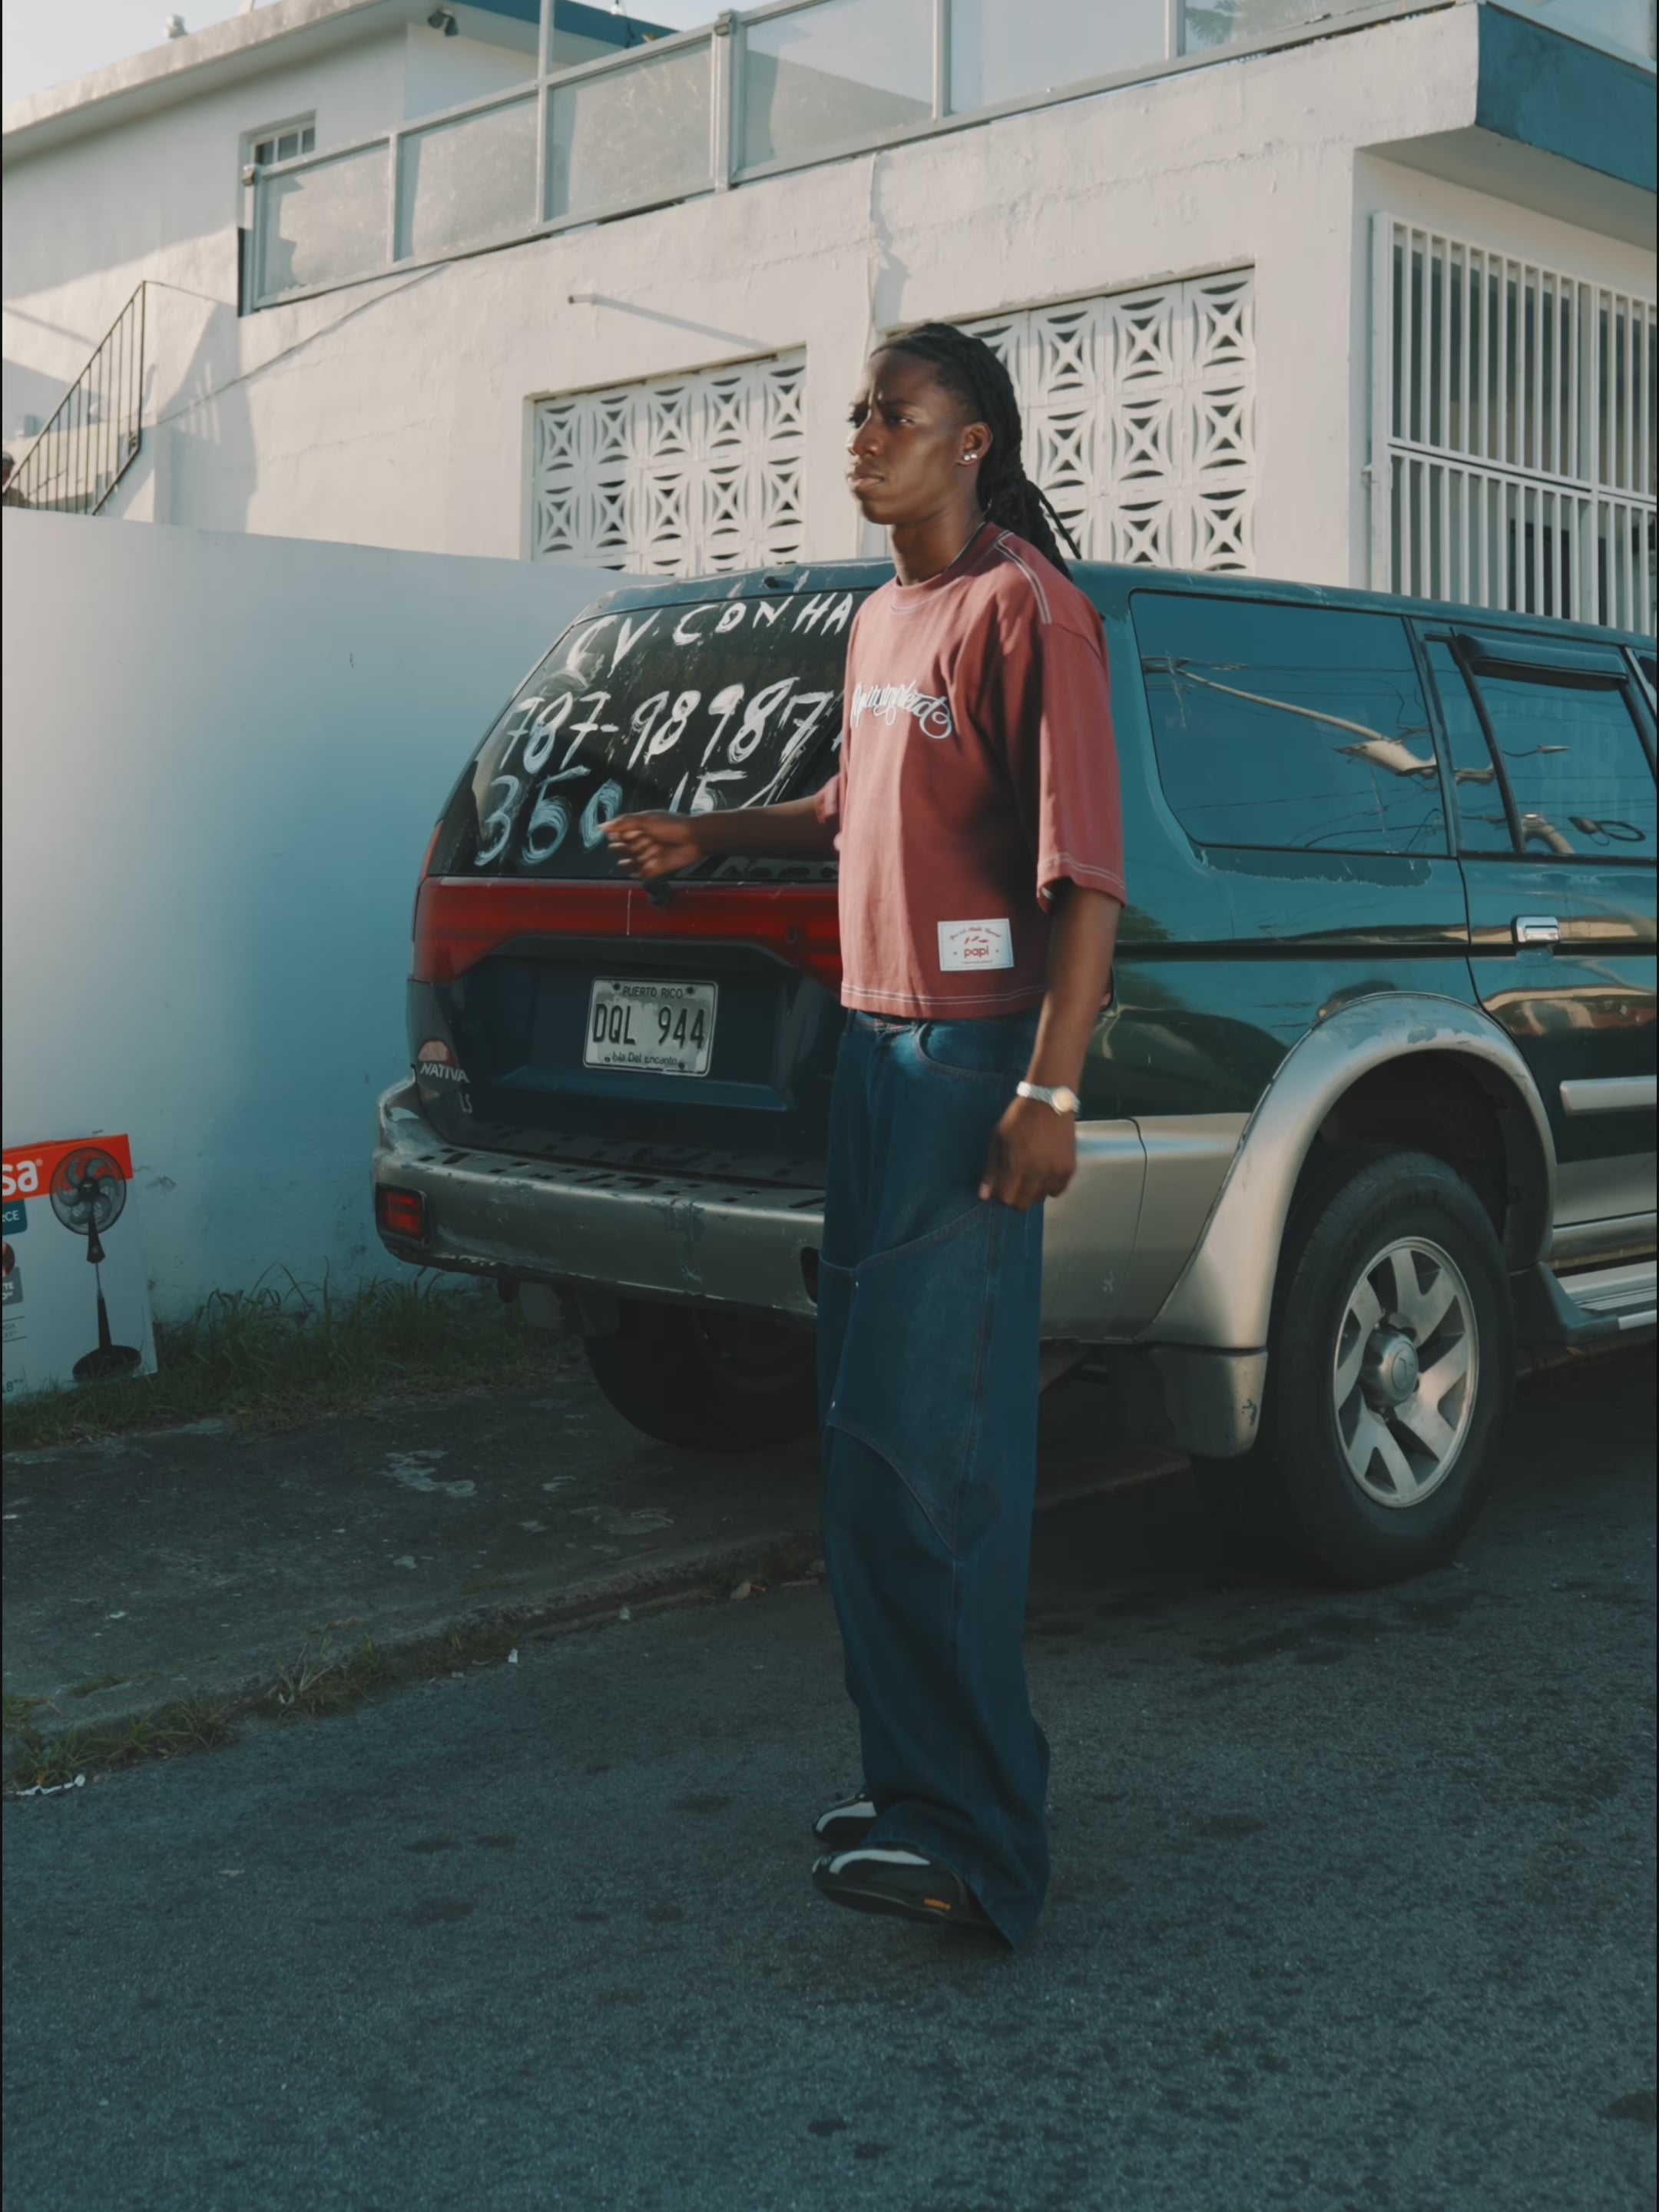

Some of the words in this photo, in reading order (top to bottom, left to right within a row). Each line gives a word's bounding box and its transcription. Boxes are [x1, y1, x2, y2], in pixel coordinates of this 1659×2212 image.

[622, 985, 657, 998] PUERTO
[661, 988, 683, 998] RICO
[592, 1003, 636, 1045] DQL
[657, 1006, 705, 1050] 944
[628, 1052, 642, 1064] Del
[419, 1062, 470, 1084] NATIVA
